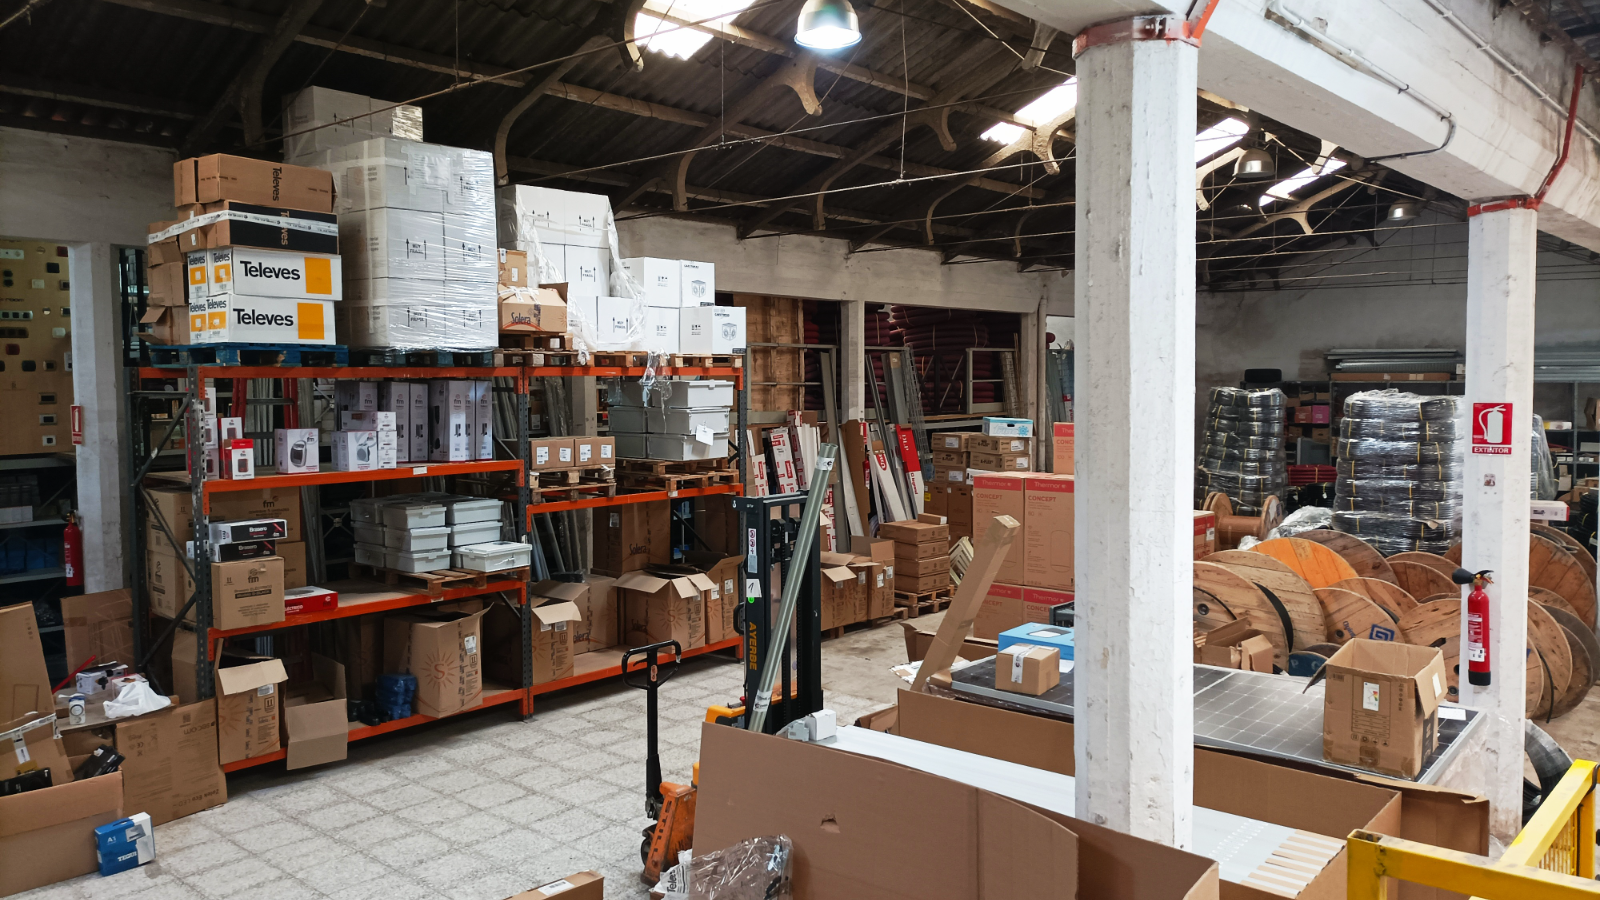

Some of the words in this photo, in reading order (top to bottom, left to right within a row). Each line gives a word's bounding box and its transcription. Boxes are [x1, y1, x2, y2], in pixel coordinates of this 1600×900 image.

[272, 166, 282, 202] Televes
[280, 211, 290, 245] Tves
[188, 255, 206, 266] Televes
[213, 252, 231, 264] Televes
[240, 260, 301, 281] Televes
[189, 302, 207, 313] Televes
[206, 299, 227, 310] Televes
[232, 308, 294, 327] Televes
[511, 311, 532, 325] Solera
[1034, 481, 1062, 489] Thermor
[976, 492, 1003, 500] CONCEPT
[263, 500, 275, 508] fm
[629, 543, 647, 555] Solera
[248, 576, 260, 584] fm
[1033, 593, 1060, 602] Thermor
[749, 621, 758, 671] AYERBE
[666, 869, 677, 893] Tele
